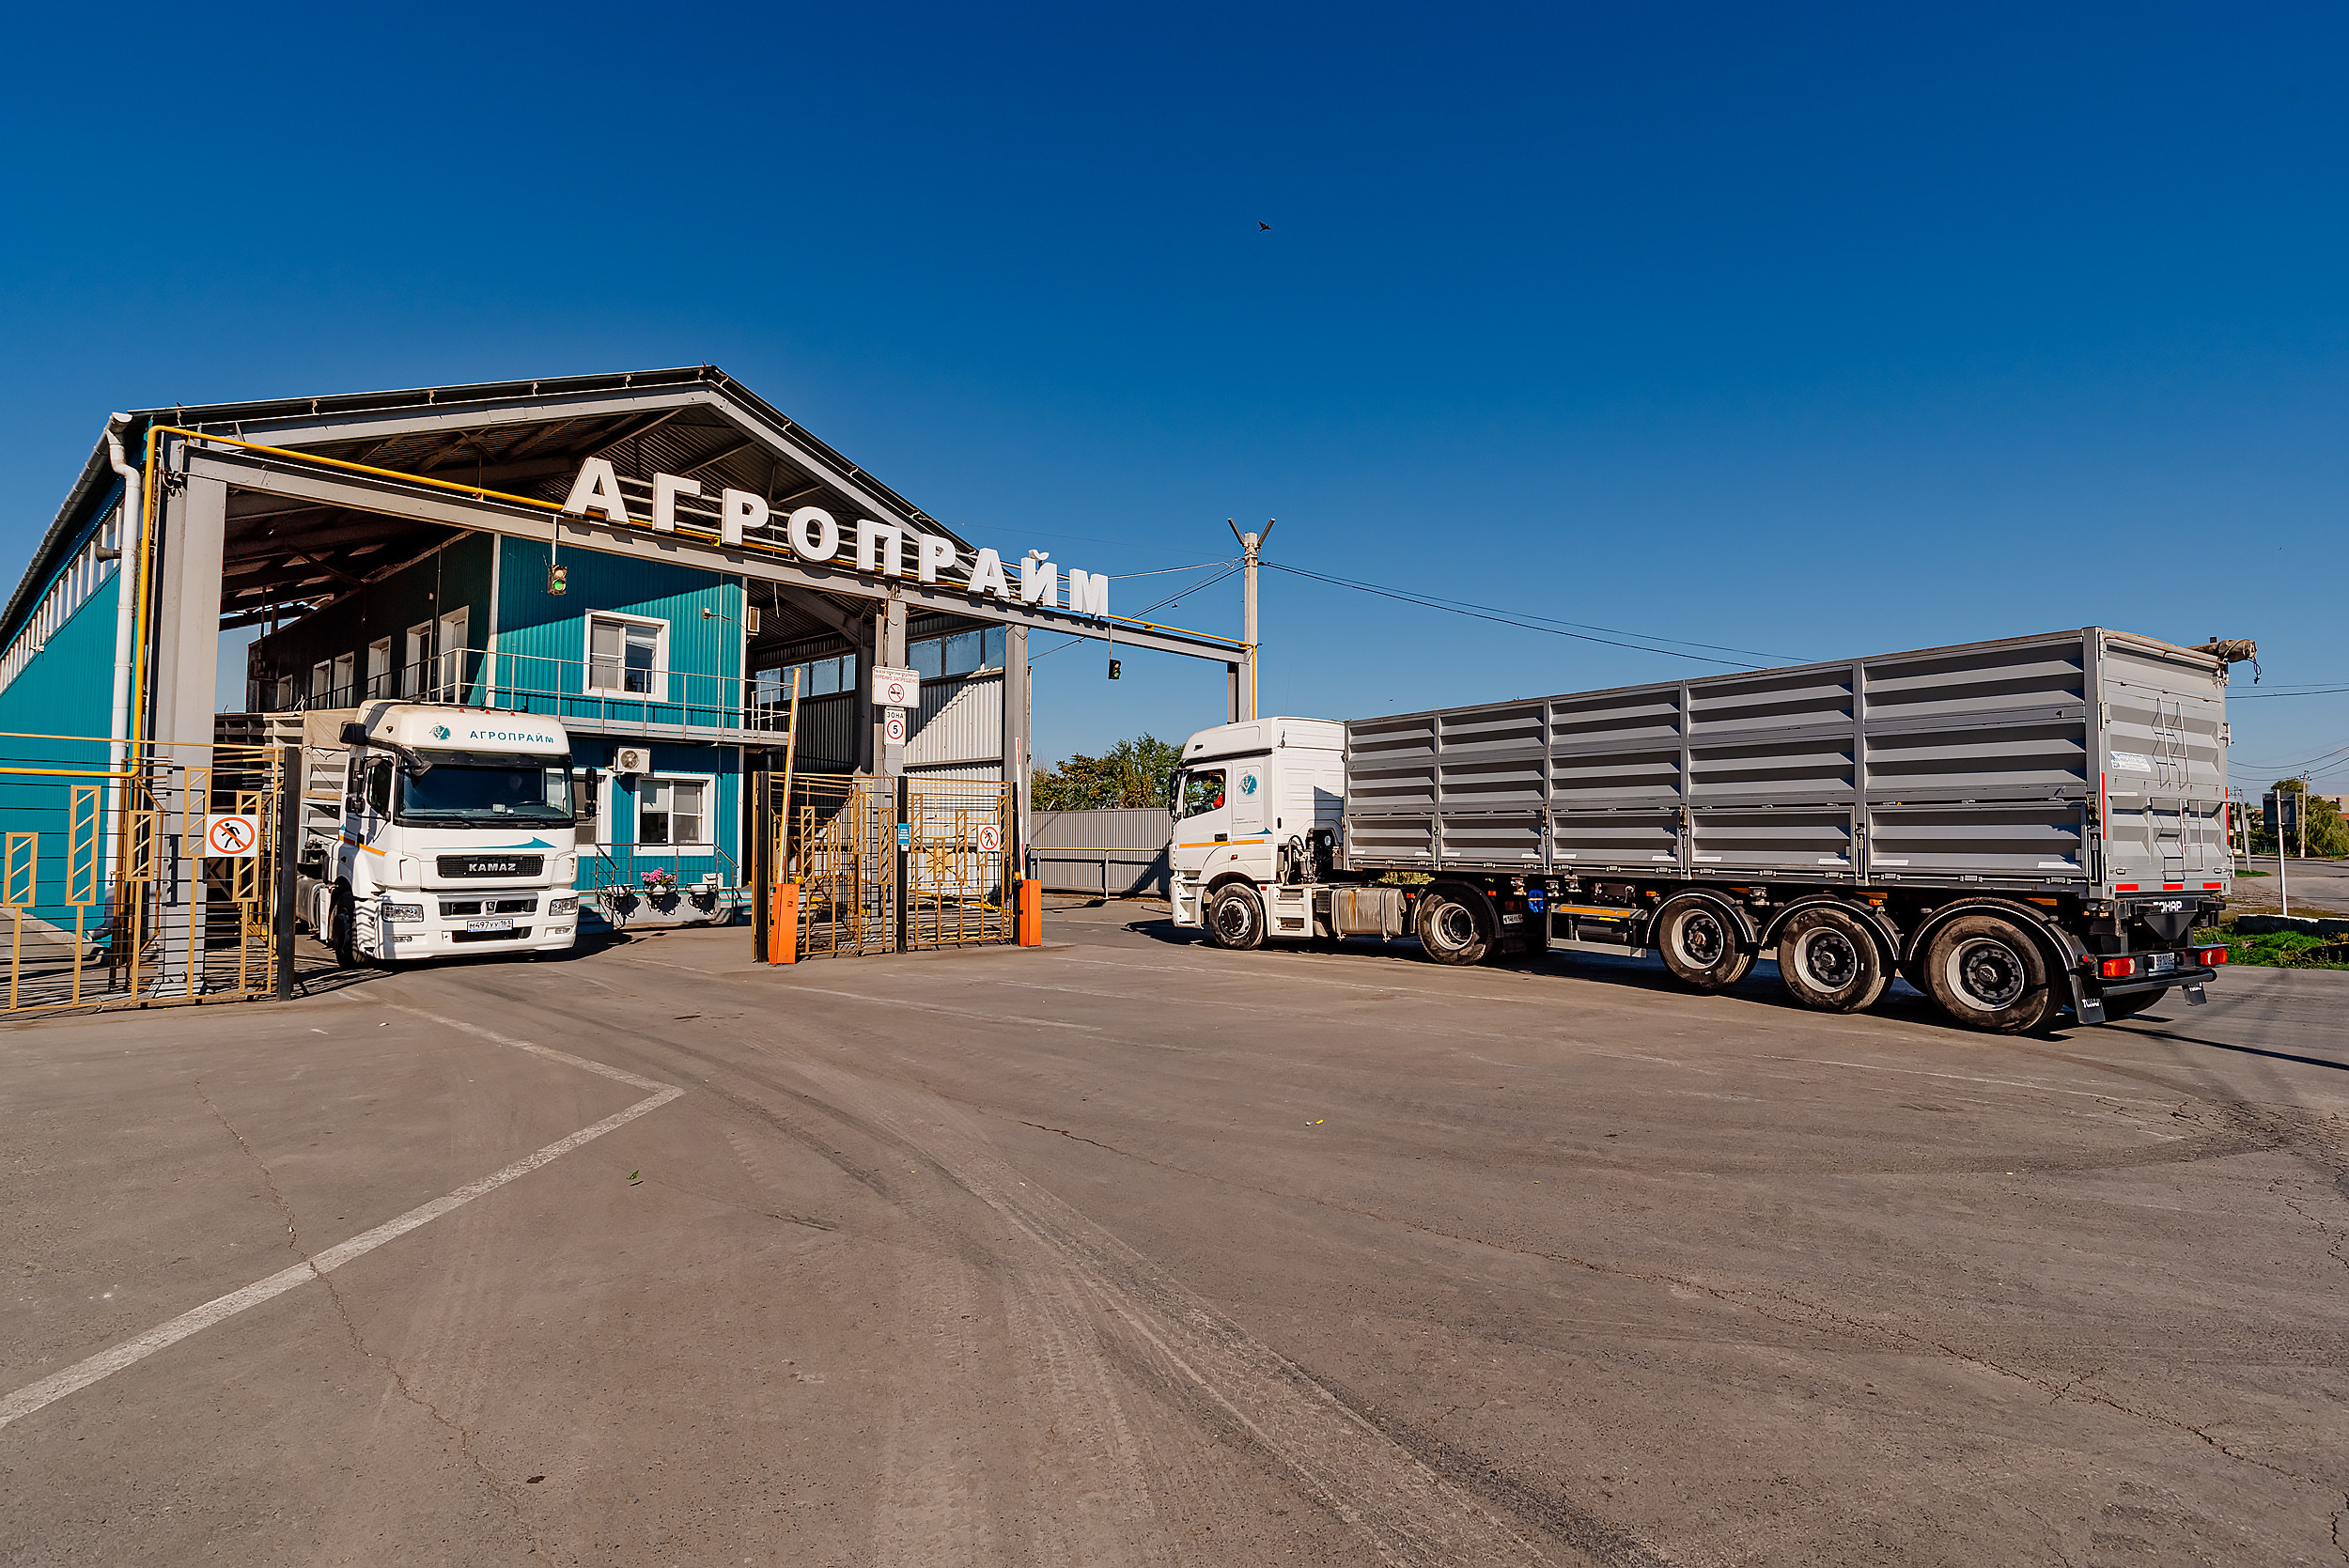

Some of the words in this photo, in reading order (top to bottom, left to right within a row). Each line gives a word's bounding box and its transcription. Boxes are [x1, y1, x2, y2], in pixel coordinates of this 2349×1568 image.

[563, 457, 1109, 616] АГРОПРАЙМ
[893, 724, 898, 735] 5
[470, 730, 554, 743] АГРОПРАЙМ
[469, 863, 517, 872] KAMAZ
